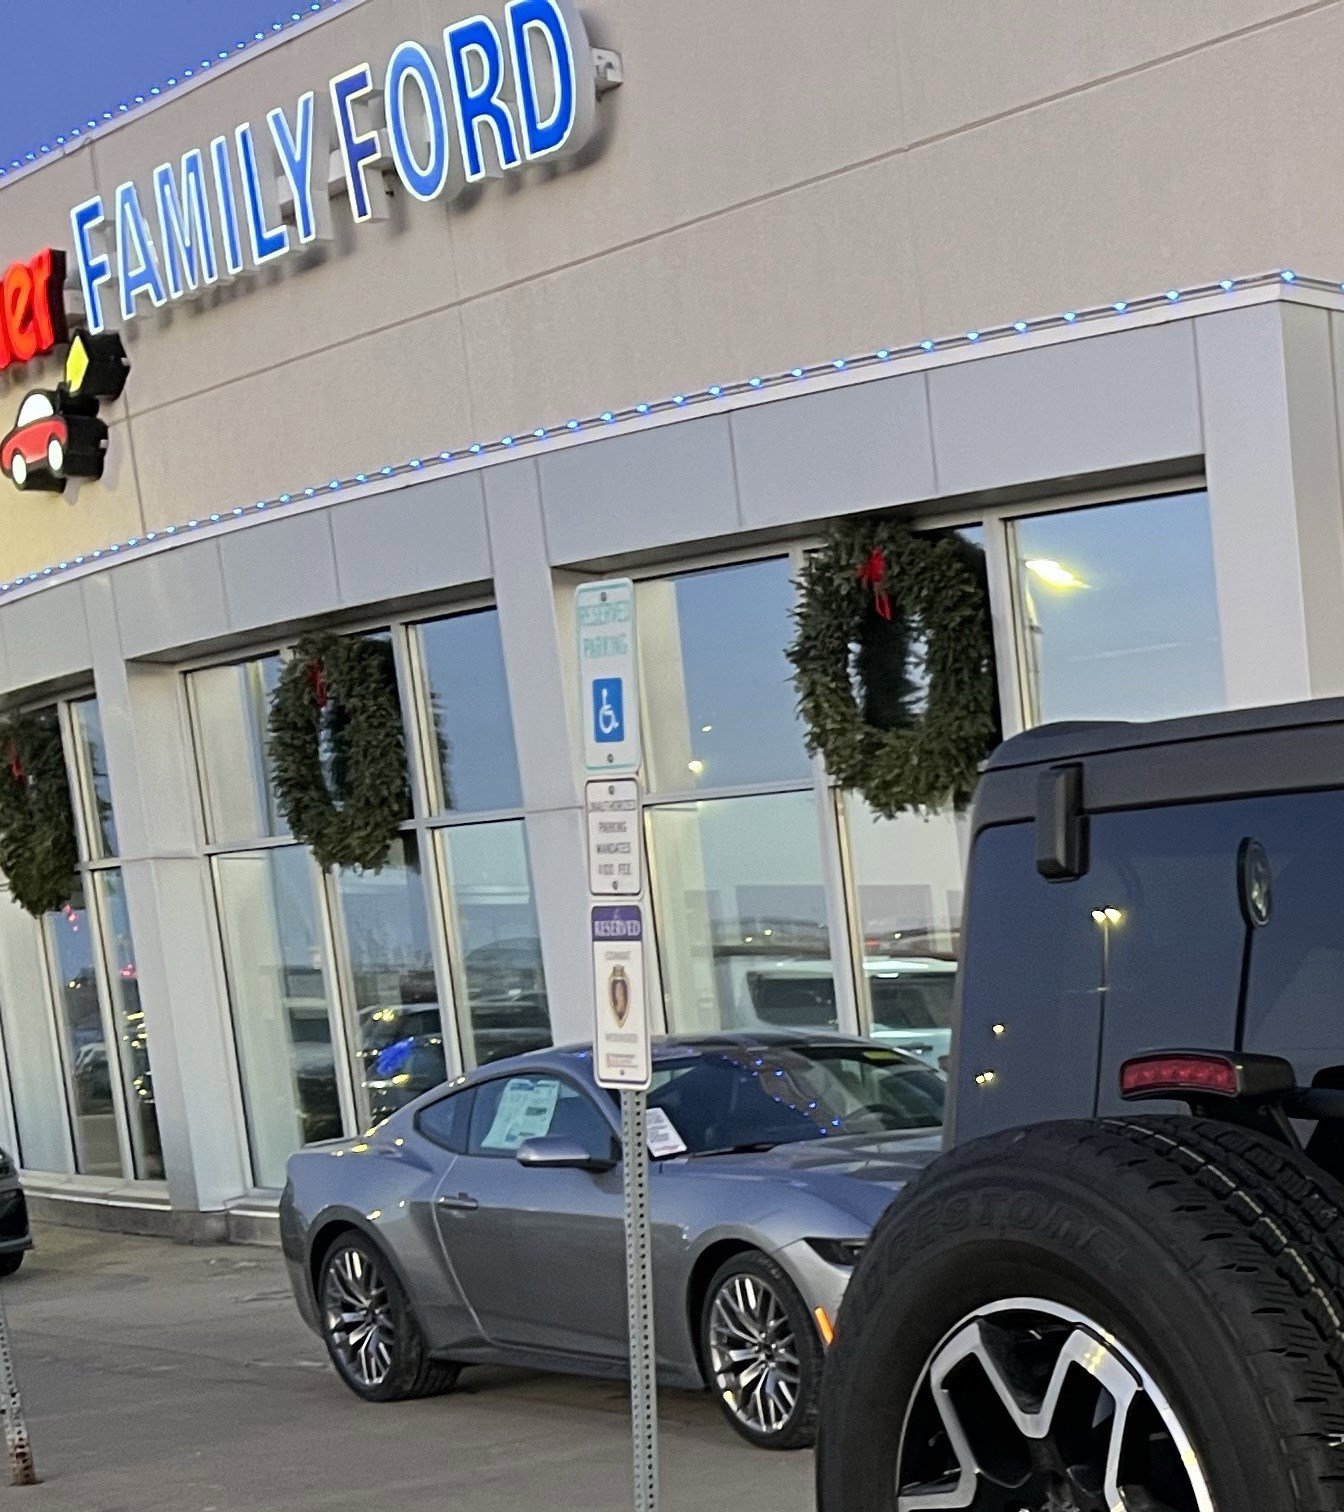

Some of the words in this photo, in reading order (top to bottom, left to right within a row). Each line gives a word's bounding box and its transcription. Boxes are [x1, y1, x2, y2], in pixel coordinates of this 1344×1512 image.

[0, 248, 55, 370] er
[71, 92, 317, 336] FAMILY
[329, 0, 577, 223] FORD
[594, 919, 641, 936] RESERVED
